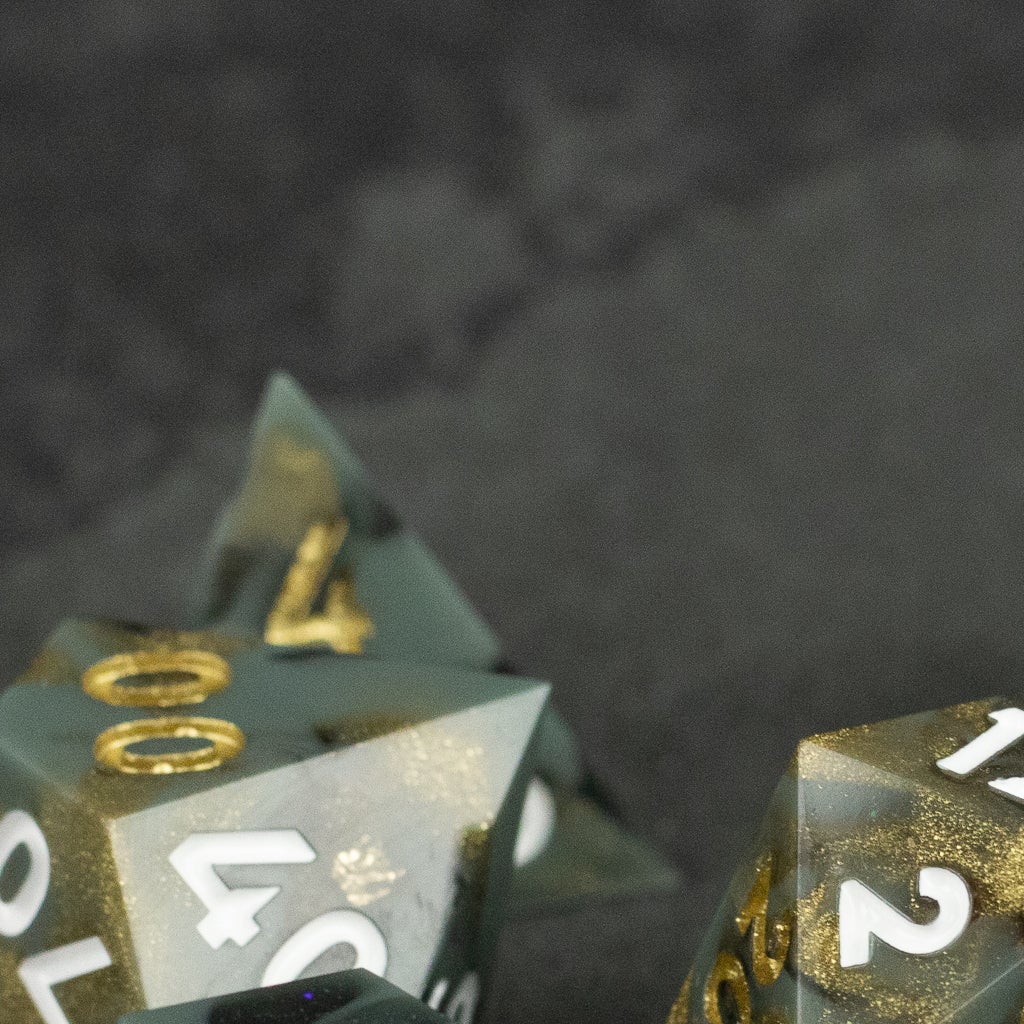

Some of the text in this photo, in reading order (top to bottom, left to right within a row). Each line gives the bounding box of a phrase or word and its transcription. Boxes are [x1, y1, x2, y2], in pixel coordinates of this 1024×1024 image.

[264, 521, 372, 655] 4
[81, 642, 245, 775] 00
[838, 866, 971, 968] 2
